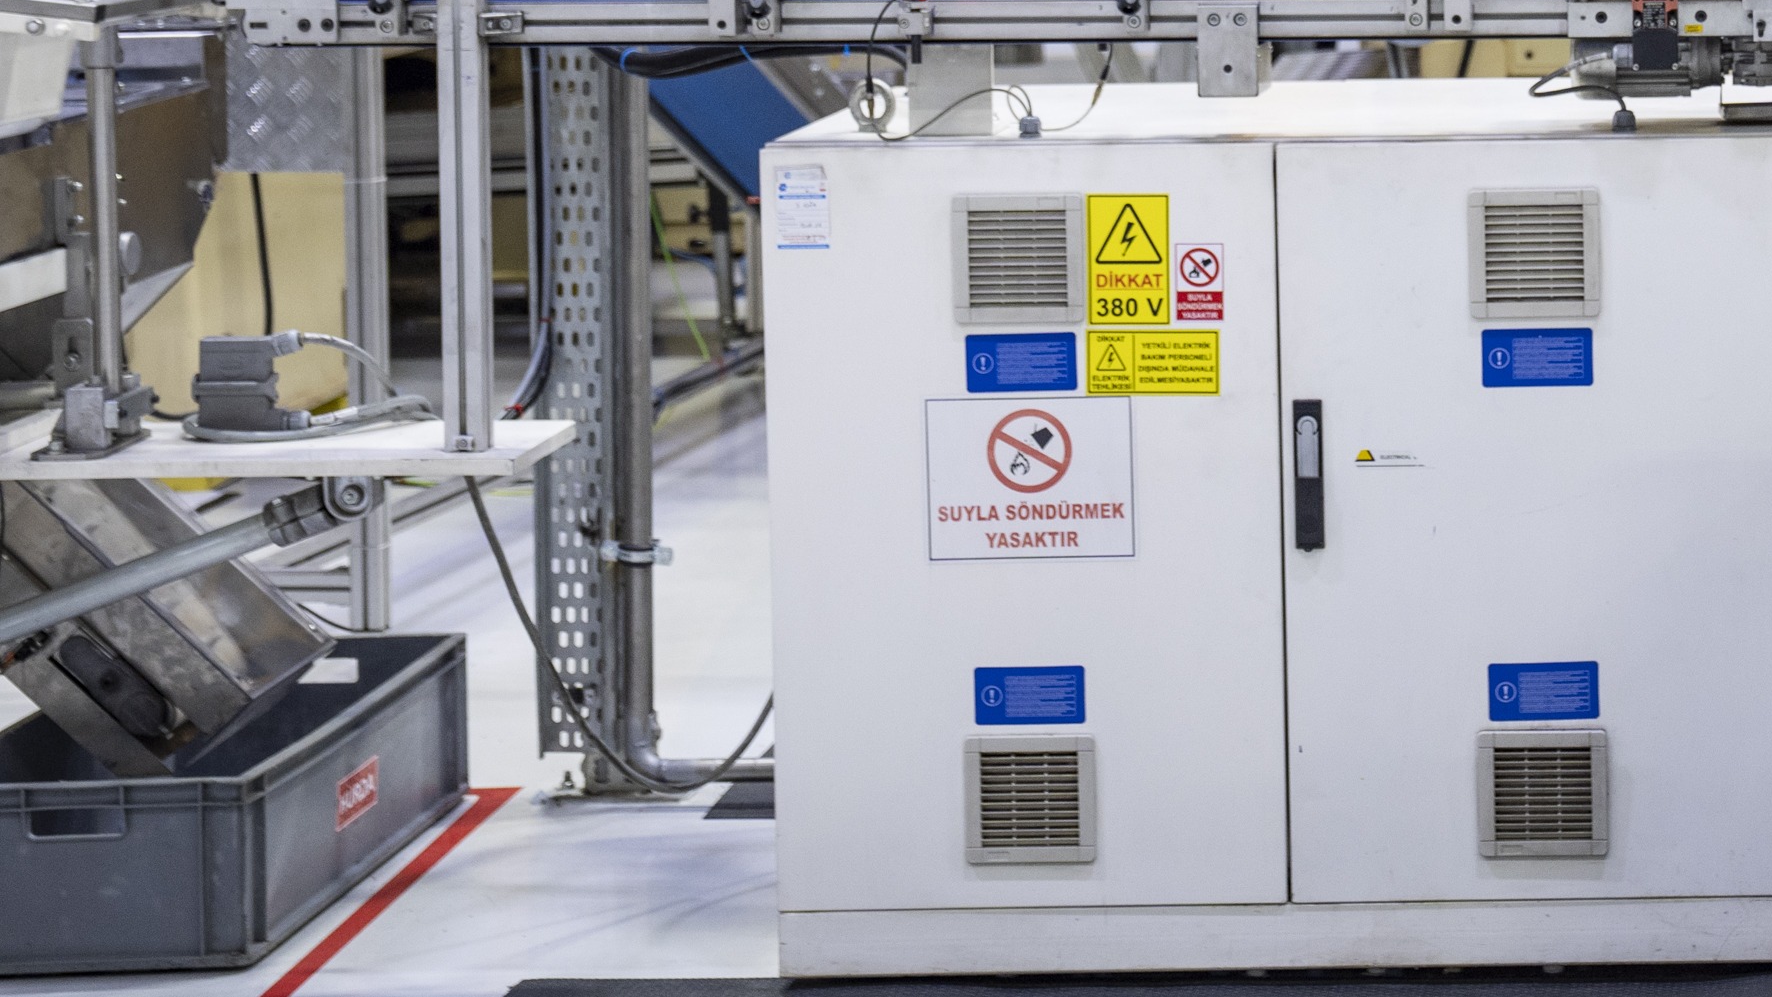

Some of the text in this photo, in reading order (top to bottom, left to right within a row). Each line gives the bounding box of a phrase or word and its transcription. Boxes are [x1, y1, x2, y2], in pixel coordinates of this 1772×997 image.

[1096, 271, 1163, 288] DİKKAT
[1187, 294, 1213, 302] SUYLA
[1097, 298, 1163, 317] 380 V
[938, 500, 1125, 522] SUYLA SÖNDÜRMEK
[985, 531, 1079, 548] YASAKTIR
[339, 774, 375, 813] HURDA
